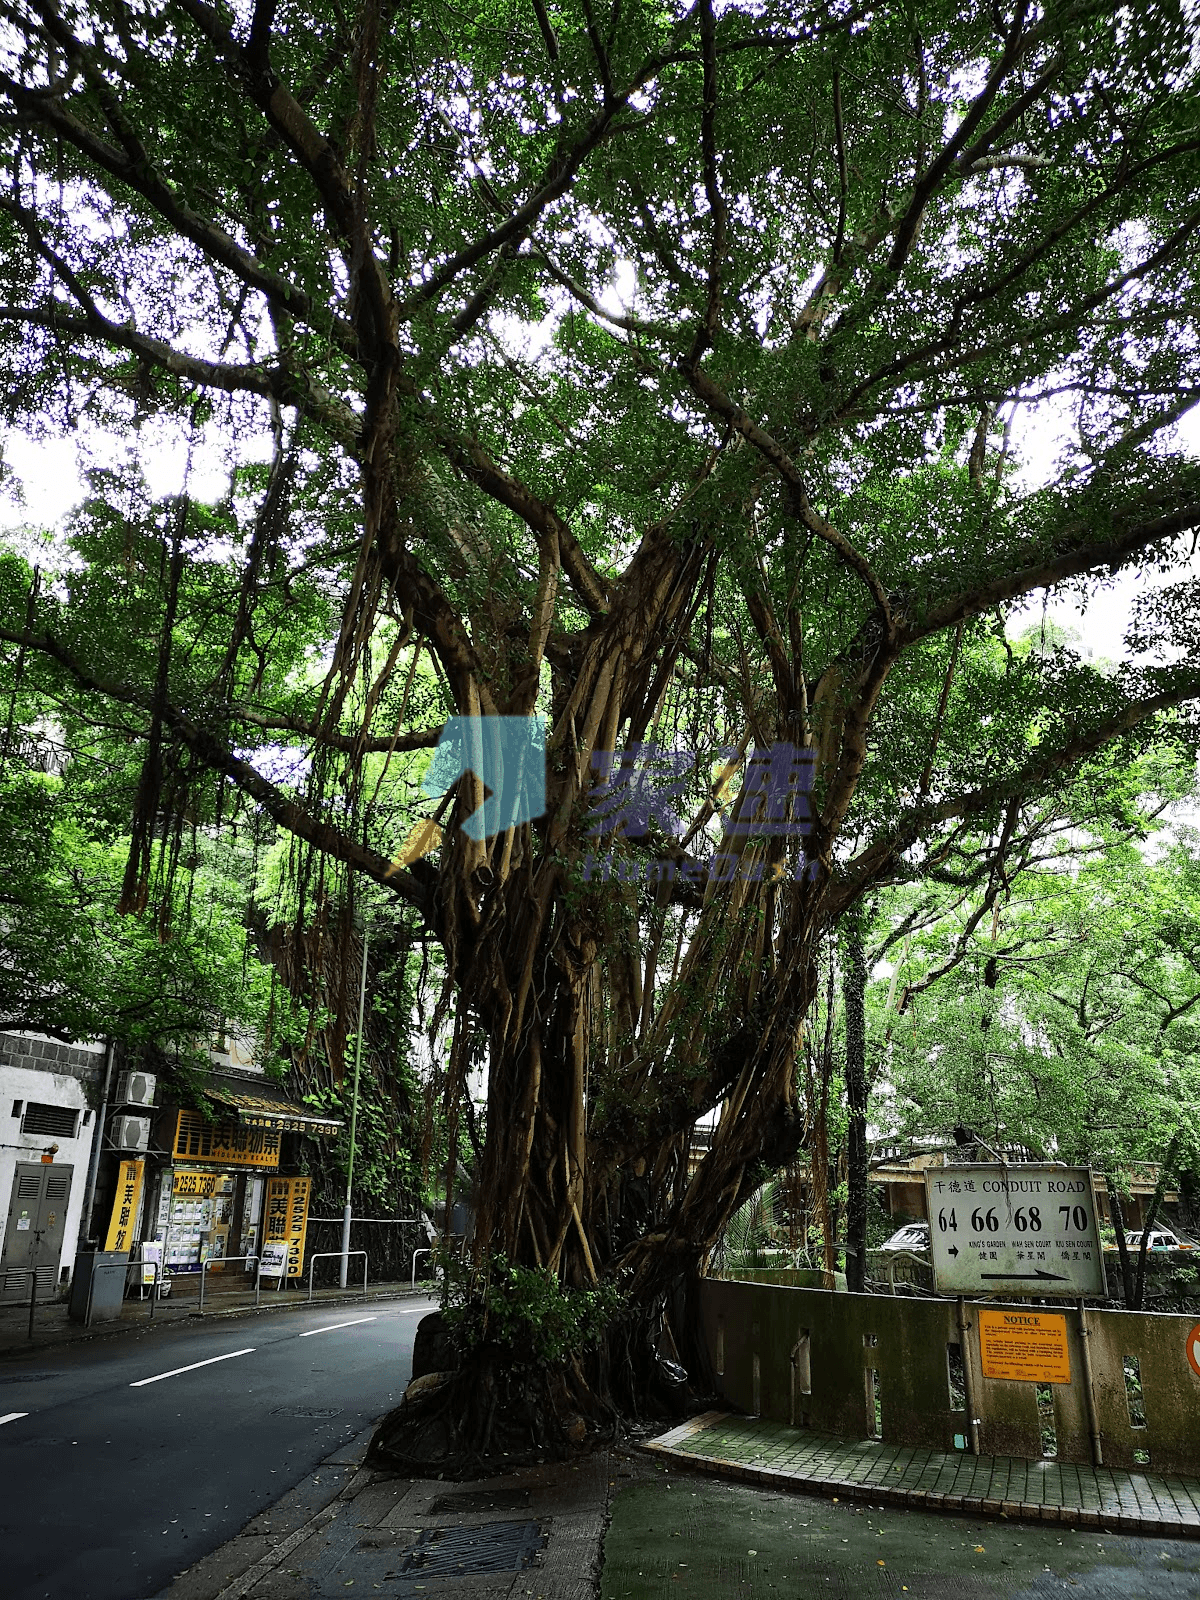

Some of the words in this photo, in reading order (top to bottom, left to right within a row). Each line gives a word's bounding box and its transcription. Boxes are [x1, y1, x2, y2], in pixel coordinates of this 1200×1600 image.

[276, 1120, 306, 1132] 2525
[179, 1175, 196, 1192] 2525
[198, 1176, 216, 1193] 7360
[933, 1179, 977, 1194] 干德道
[982, 1180, 1042, 1193] CONDUIT
[1047, 1180, 1086, 1193] ROAD
[938, 1207, 958, 1232] 64
[971, 1206, 999, 1232] 66
[1014, 1206, 1042, 1232] 68
[1058, 1205, 1088, 1232] 70
[969, 1240, 985, 1248] KING'S
[986, 1240, 1006, 1248] GARDEN
[1024, 1240, 1035, 1248] SEN
[1036, 1240, 1052, 1248] COURT
[1065, 1240, 1076, 1248] SEN
[1076, 1240, 1093, 1248] COURT
[1003, 1315, 1040, 1325] NOTICE
